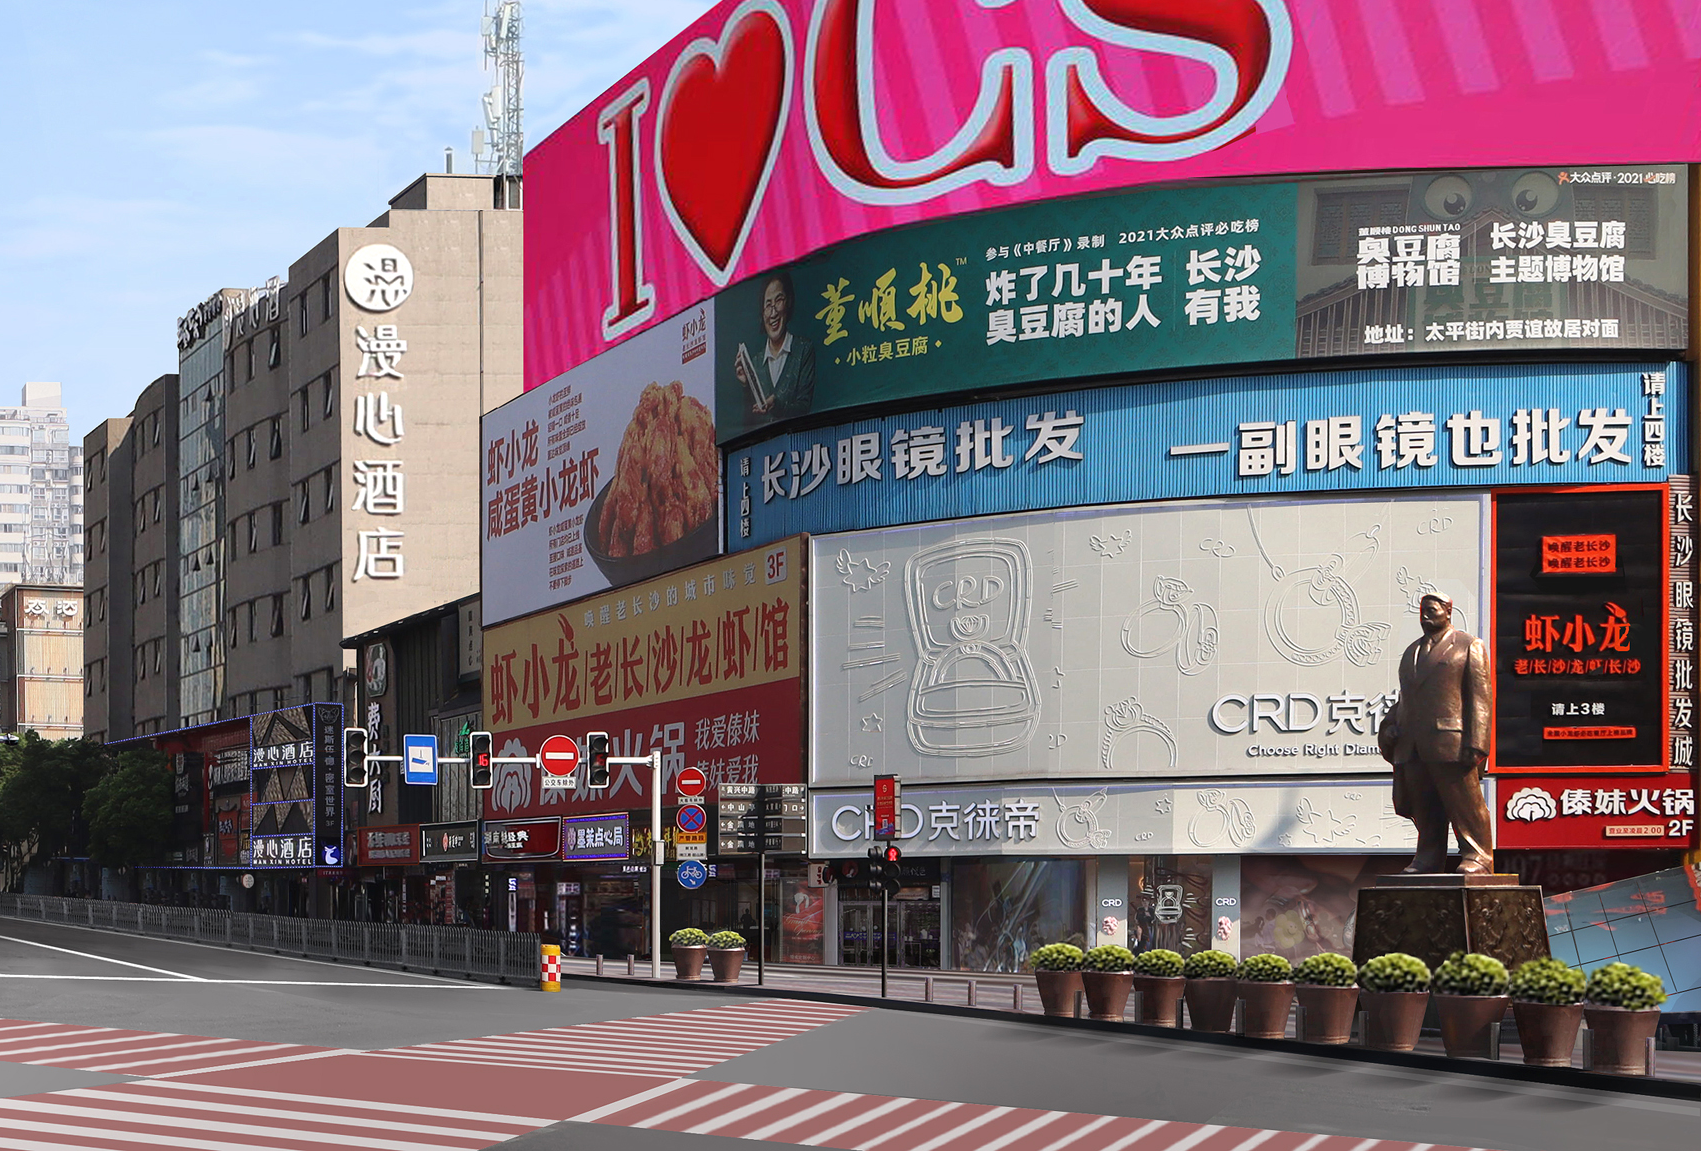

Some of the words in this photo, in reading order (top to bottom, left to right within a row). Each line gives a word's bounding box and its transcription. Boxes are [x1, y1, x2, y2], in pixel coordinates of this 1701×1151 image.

[1118, 218, 1260, 245] 2021大众点评必吃榜
[1392, 225, 1417, 234] DONG
[1418, 224, 1441, 233] SHUN
[1442, 222, 1461, 231] TAO
[1490, 220, 1626, 249] 长沙臭豆腐
[985, 234, 1105, 261] 参与《中餐厅》录制
[1356, 233, 1461, 264] 臭豆腐
[985, 255, 1163, 306] 炸了几十年
[1185, 244, 1262, 286] 长沙
[1356, 258, 1461, 290] 博物馆
[1490, 254, 1626, 284] 主题博物馆
[986, 293, 1162, 346] 臭豆腐的人
[1184, 285, 1261, 326] 有我
[846, 336, 929, 366] 小粒臭豆腐
[1640, 371, 1667, 469] 请上四楼
[351, 324, 408, 583] 漫心酒店
[487, 418, 540, 487] 虾小龙
[761, 410, 1085, 504] 长沙眼镜批发
[1170, 408, 1633, 479] 一副眼镜也批发
[487, 447, 600, 542] 咸蛋黄小龙虾
[740, 457, 750, 539] 请上四楼
[767, 550, 784, 580] 3F
[584, 562, 757, 629] 唤醒老长沙的城市味觉
[1524, 605, 1632, 653] 虾小龙
[1674, 490, 1694, 768] 长沙眼镜批发城
[1212, 692, 1324, 734] CRD
[1551, 702, 1606, 716] 请上3楼
[694, 709, 760, 751] 我爱傣妹
[253, 741, 314, 763] 漫心酒店
[1247, 743, 1299, 757] Choose
[1302, 742, 1340, 759] Right
[726, 785, 756, 795] 黄兴中路
[1560, 788, 1695, 816] 傣妹火锅
[1668, 819, 1694, 837] 2F
[253, 837, 312, 860] 漫心酒店
[1101, 897, 1123, 908] CRD
[1215, 897, 1237, 907] CRD
